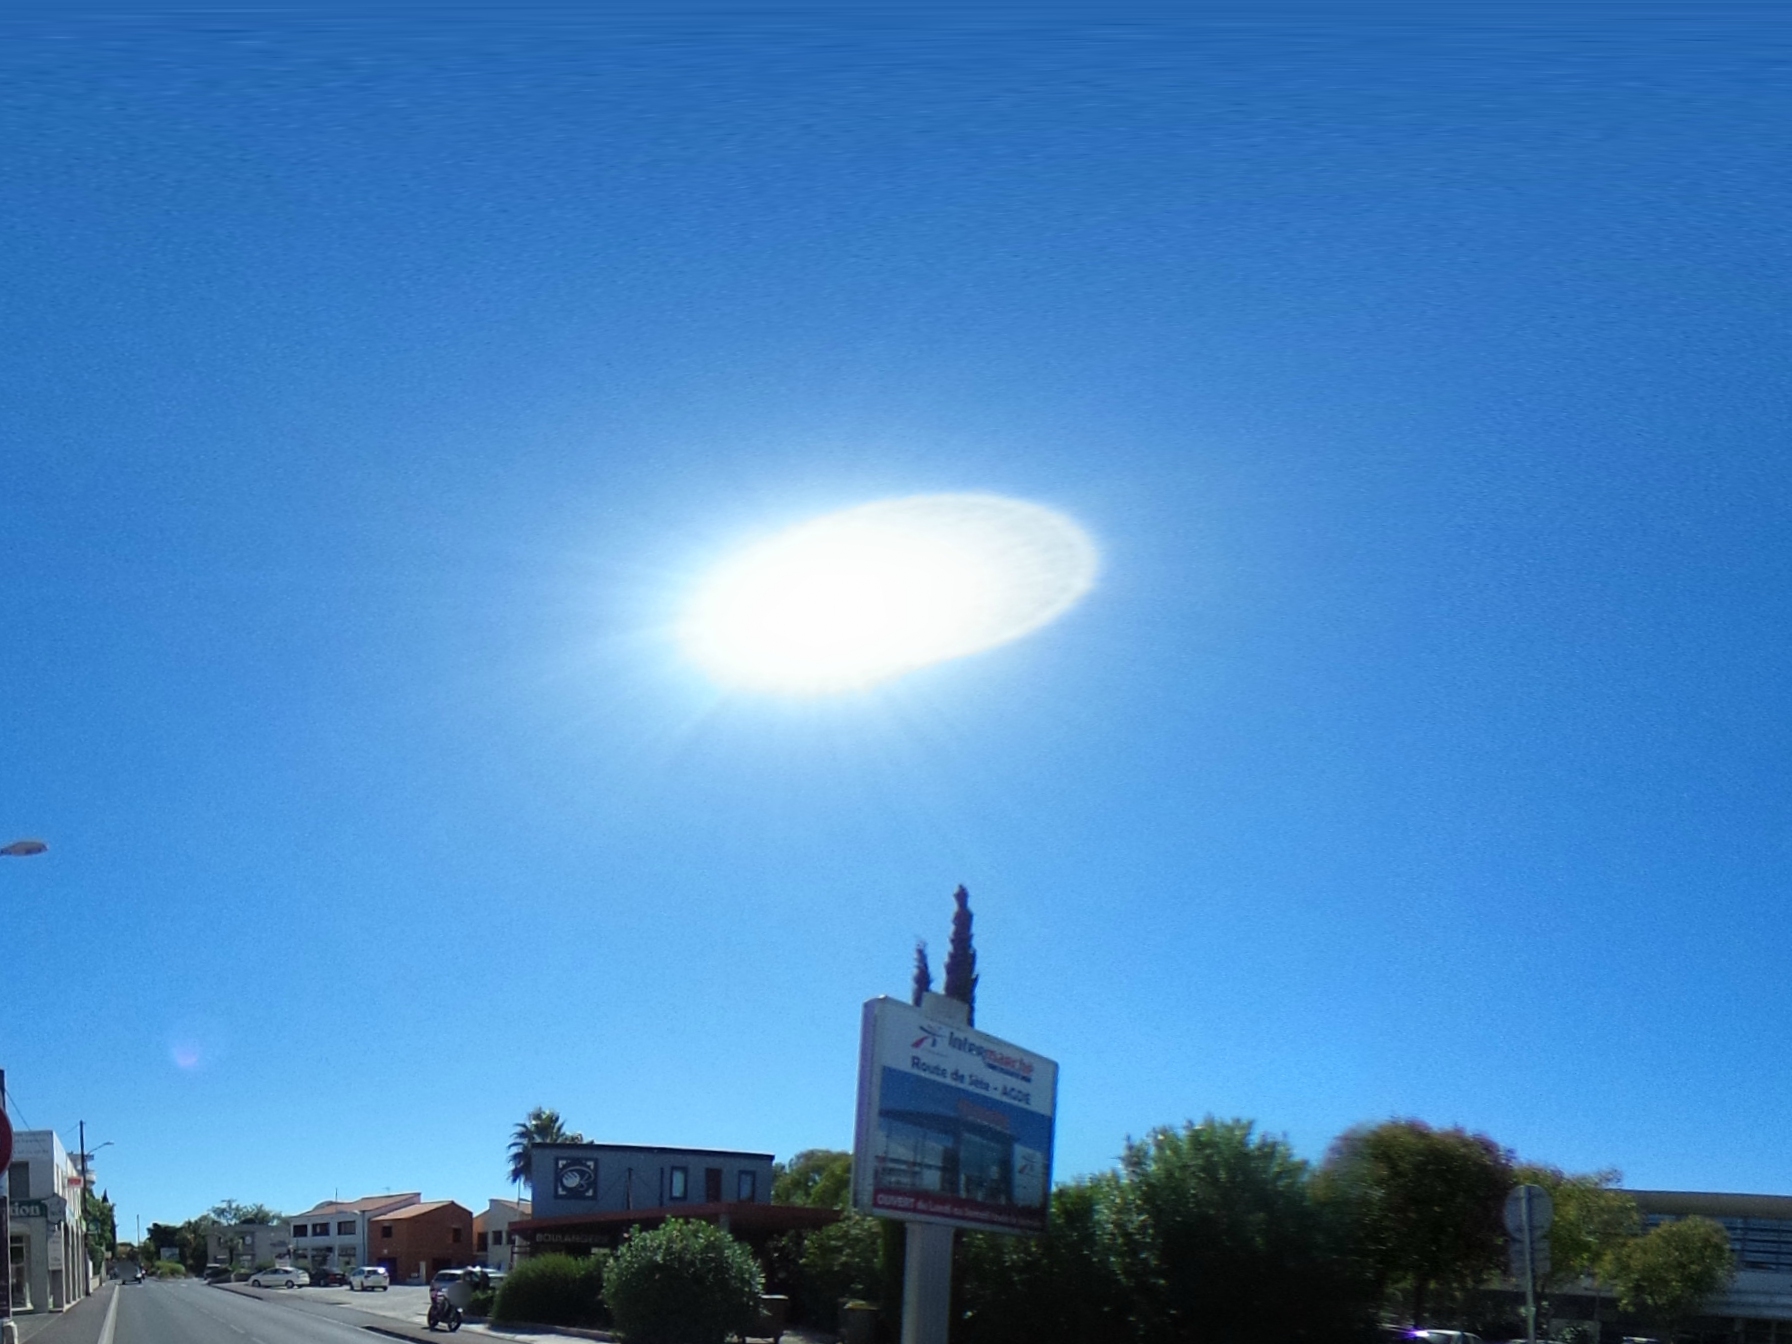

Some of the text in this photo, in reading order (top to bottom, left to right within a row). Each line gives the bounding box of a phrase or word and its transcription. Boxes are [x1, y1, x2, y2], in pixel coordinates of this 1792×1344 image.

[911, 1055, 948, 1079] Route
[950, 1065, 965, 1083] de
[876, 1194, 915, 1208] OUVERT
